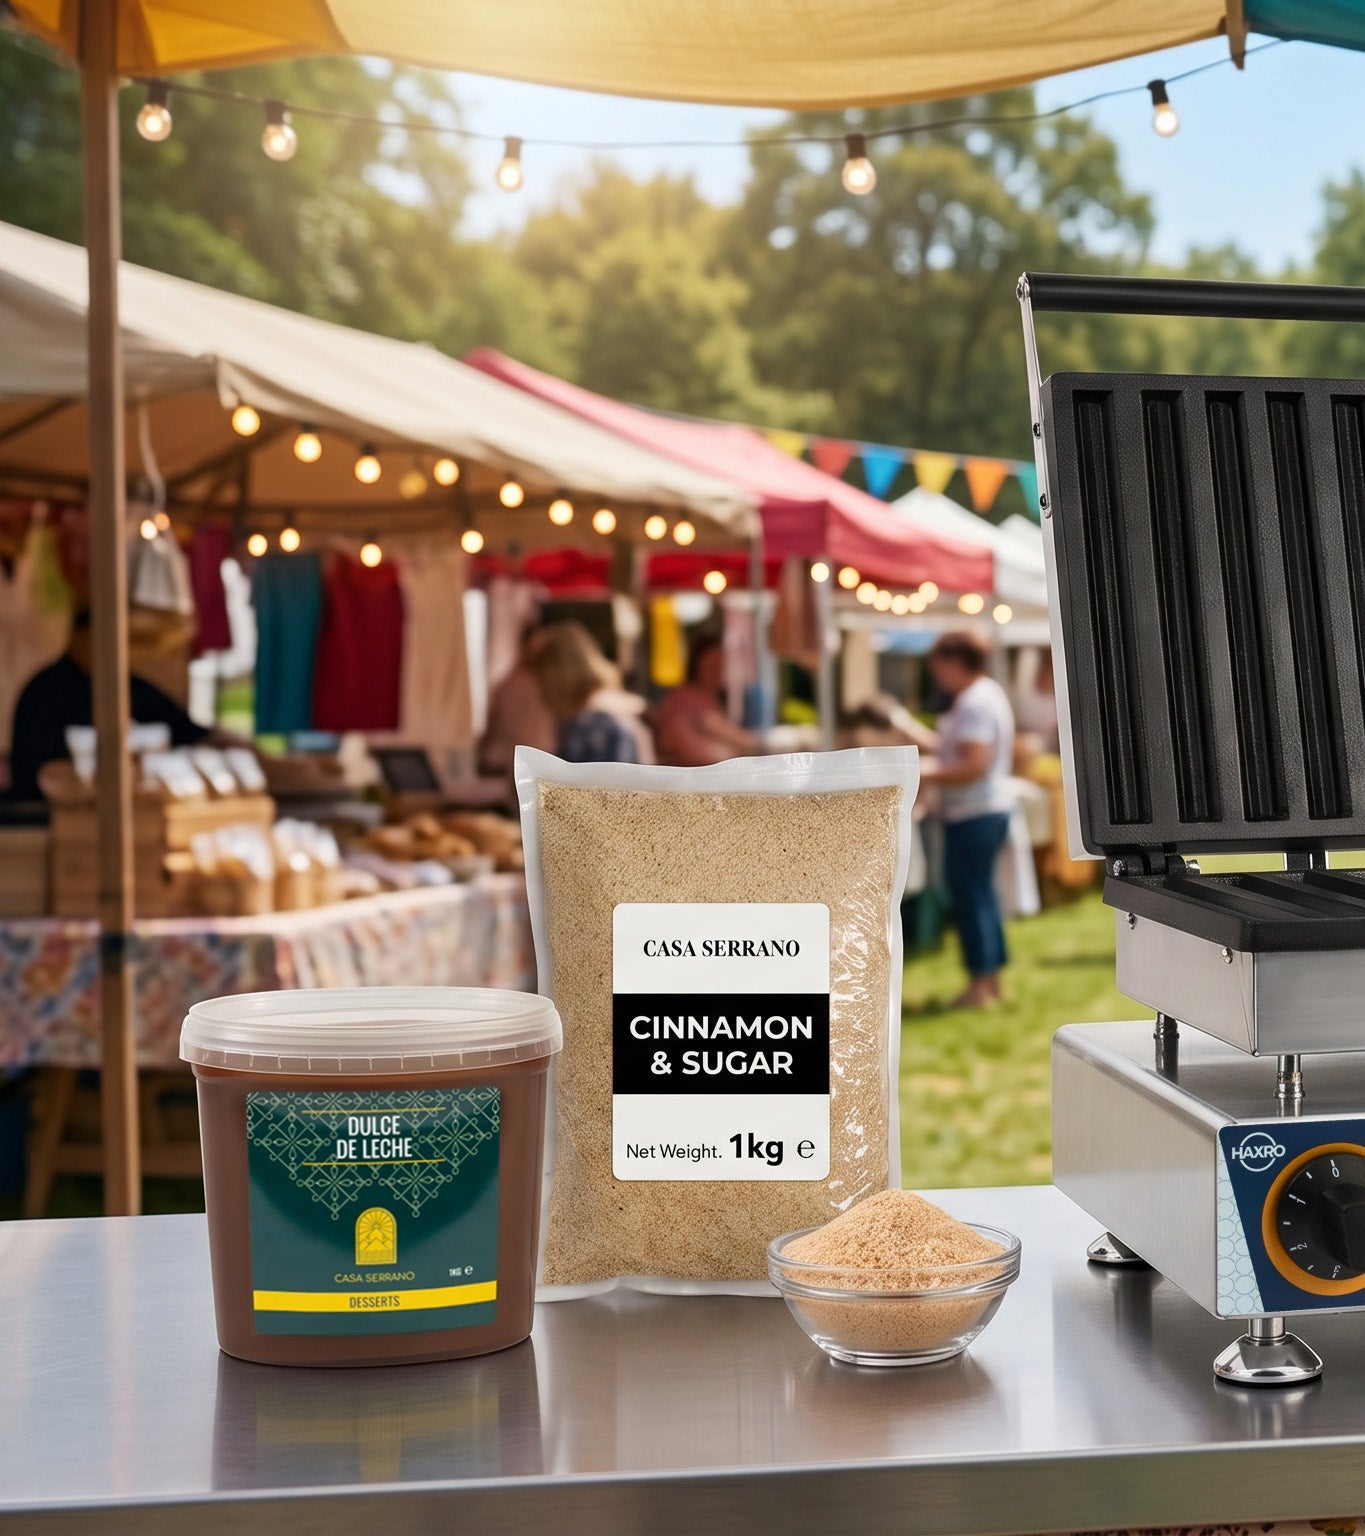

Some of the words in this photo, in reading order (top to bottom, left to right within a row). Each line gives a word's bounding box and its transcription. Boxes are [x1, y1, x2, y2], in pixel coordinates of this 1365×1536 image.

[643, 938, 697, 958] CASA
[701, 938, 800, 958] SERRANO
[629, 1015, 813, 1040] CINNAMON
[649, 1050, 673, 1075] &
[682, 1050, 793, 1075] SUGAR
[347, 1115, 400, 1136] DULCE
[336, 1139, 357, 1159] DE
[362, 1138, 413, 1158] LECHE
[626, 1143, 656, 1159] Net
[659, 1143, 723, 1162] Weight.
[729, 1132, 785, 1166] 1kg
[1231, 1144, 1286, 1160] HAXRO
[333, 1273, 363, 1284] CASA
[365, 1271, 415, 1283] SERRANO
[349, 1295, 400, 1308] DESSERTS
